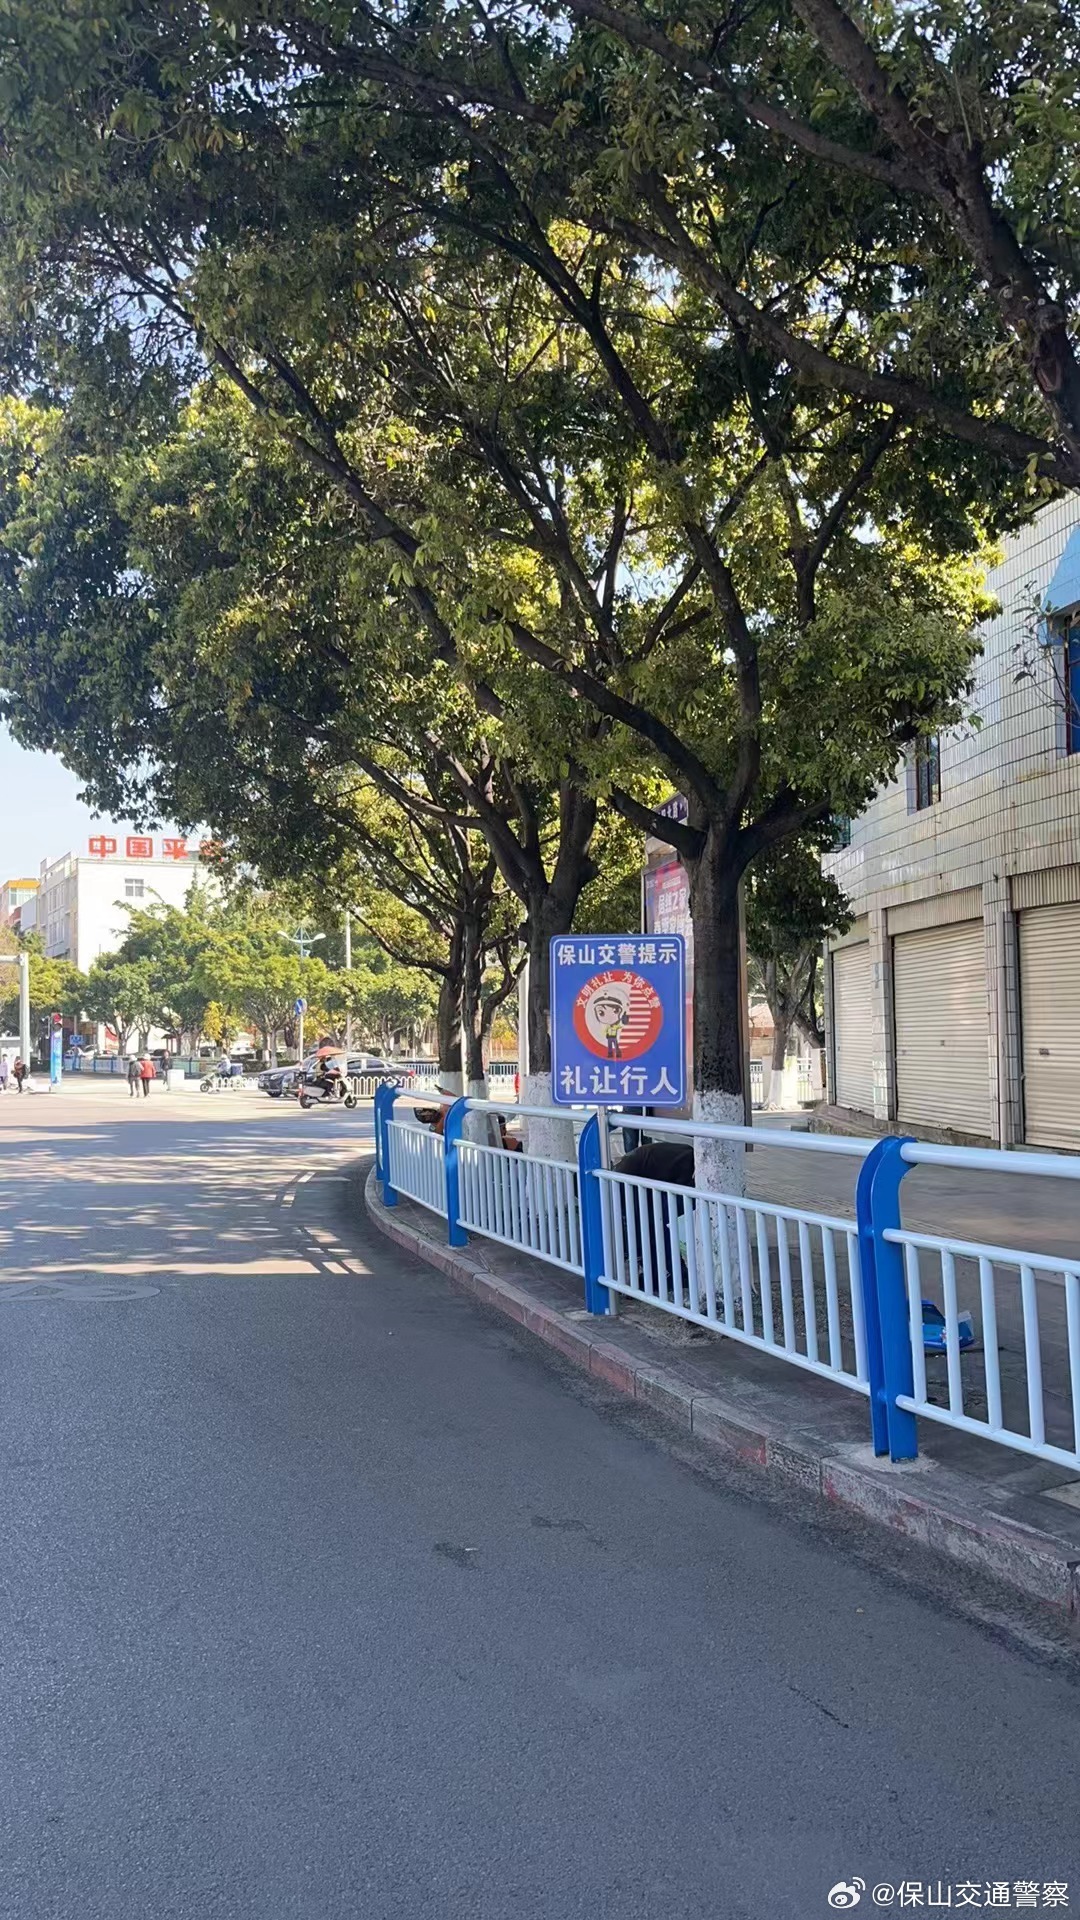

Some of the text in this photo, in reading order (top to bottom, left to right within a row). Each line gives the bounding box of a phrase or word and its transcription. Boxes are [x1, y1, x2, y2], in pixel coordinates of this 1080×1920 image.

[557, 943, 678, 966] 保山交警提示
[560, 1065, 679, 1096] 礼让行人
